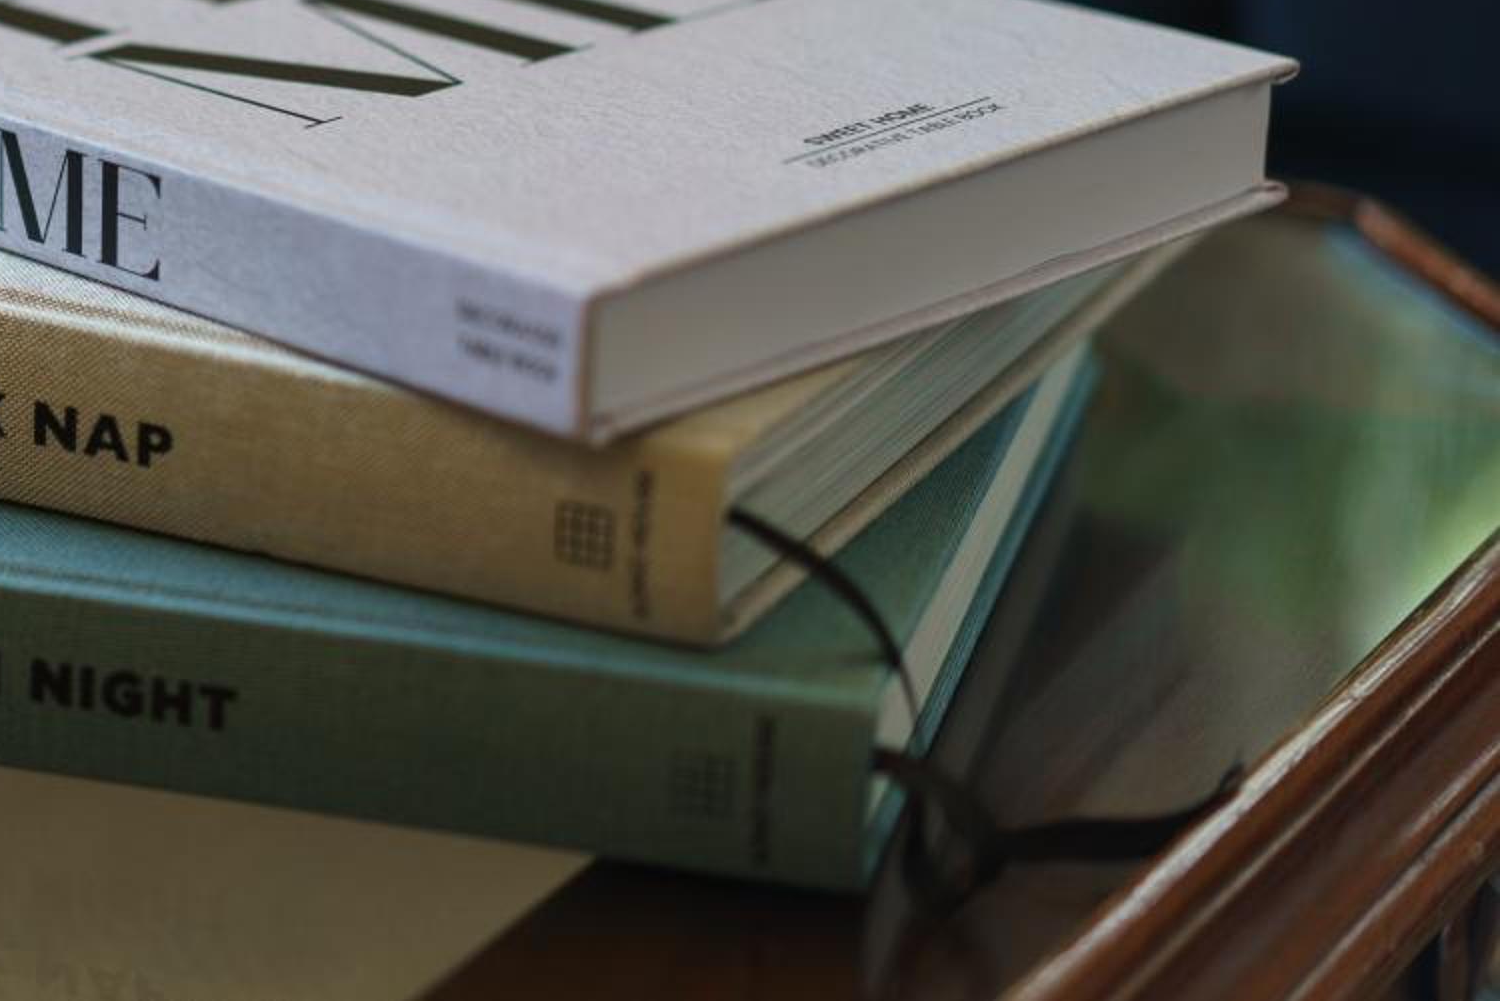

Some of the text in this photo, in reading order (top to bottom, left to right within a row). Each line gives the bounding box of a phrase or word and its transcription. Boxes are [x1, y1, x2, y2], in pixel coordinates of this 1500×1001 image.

[802, 102, 936, 146] SWEET HOME
[33, 400, 175, 469] NAP
[29, 657, 240, 732] NIGHT
